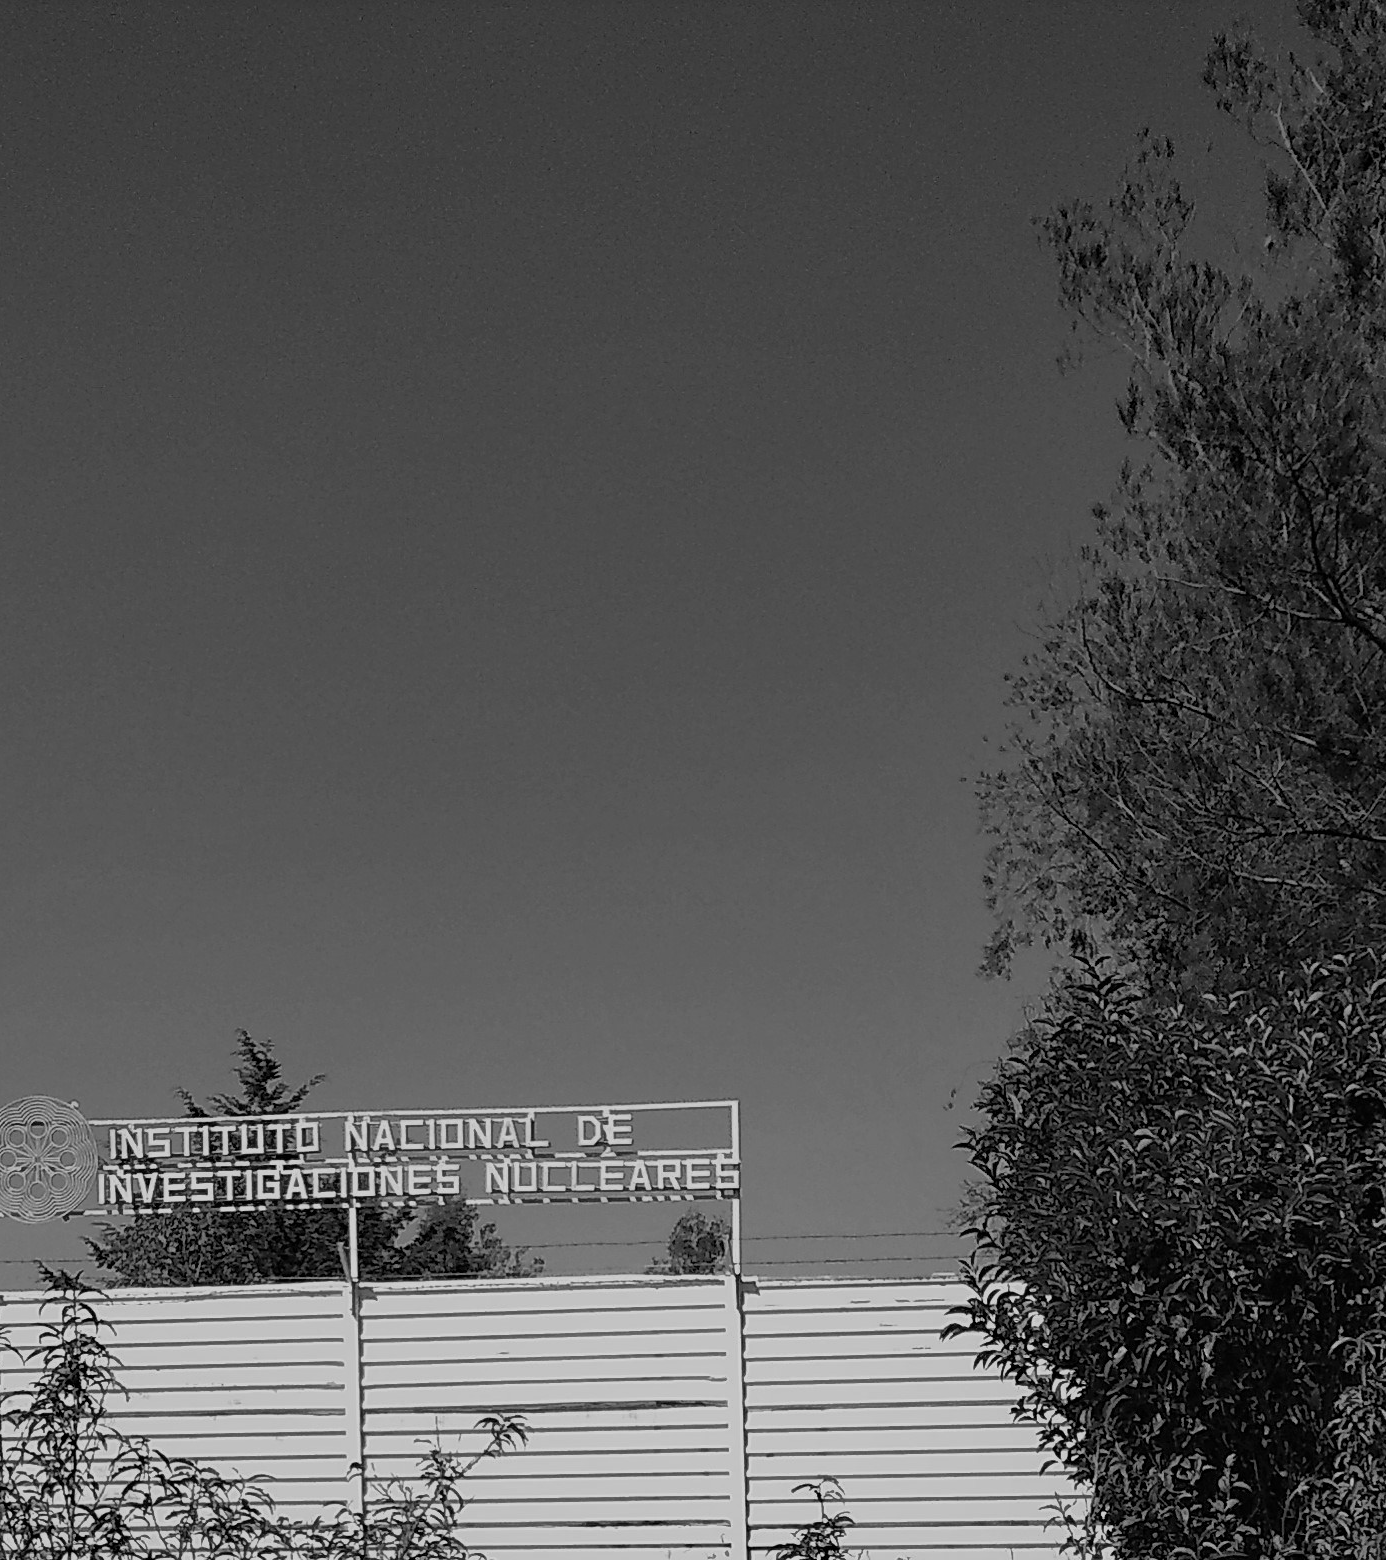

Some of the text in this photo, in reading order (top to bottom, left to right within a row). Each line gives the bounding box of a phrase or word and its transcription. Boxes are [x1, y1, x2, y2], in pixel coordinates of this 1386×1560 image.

[109, 1113, 634, 1159] INSTITUTO NACIONAL DE
[98, 1158, 740, 1205] INVESTIGACIONES NUCLEARES
